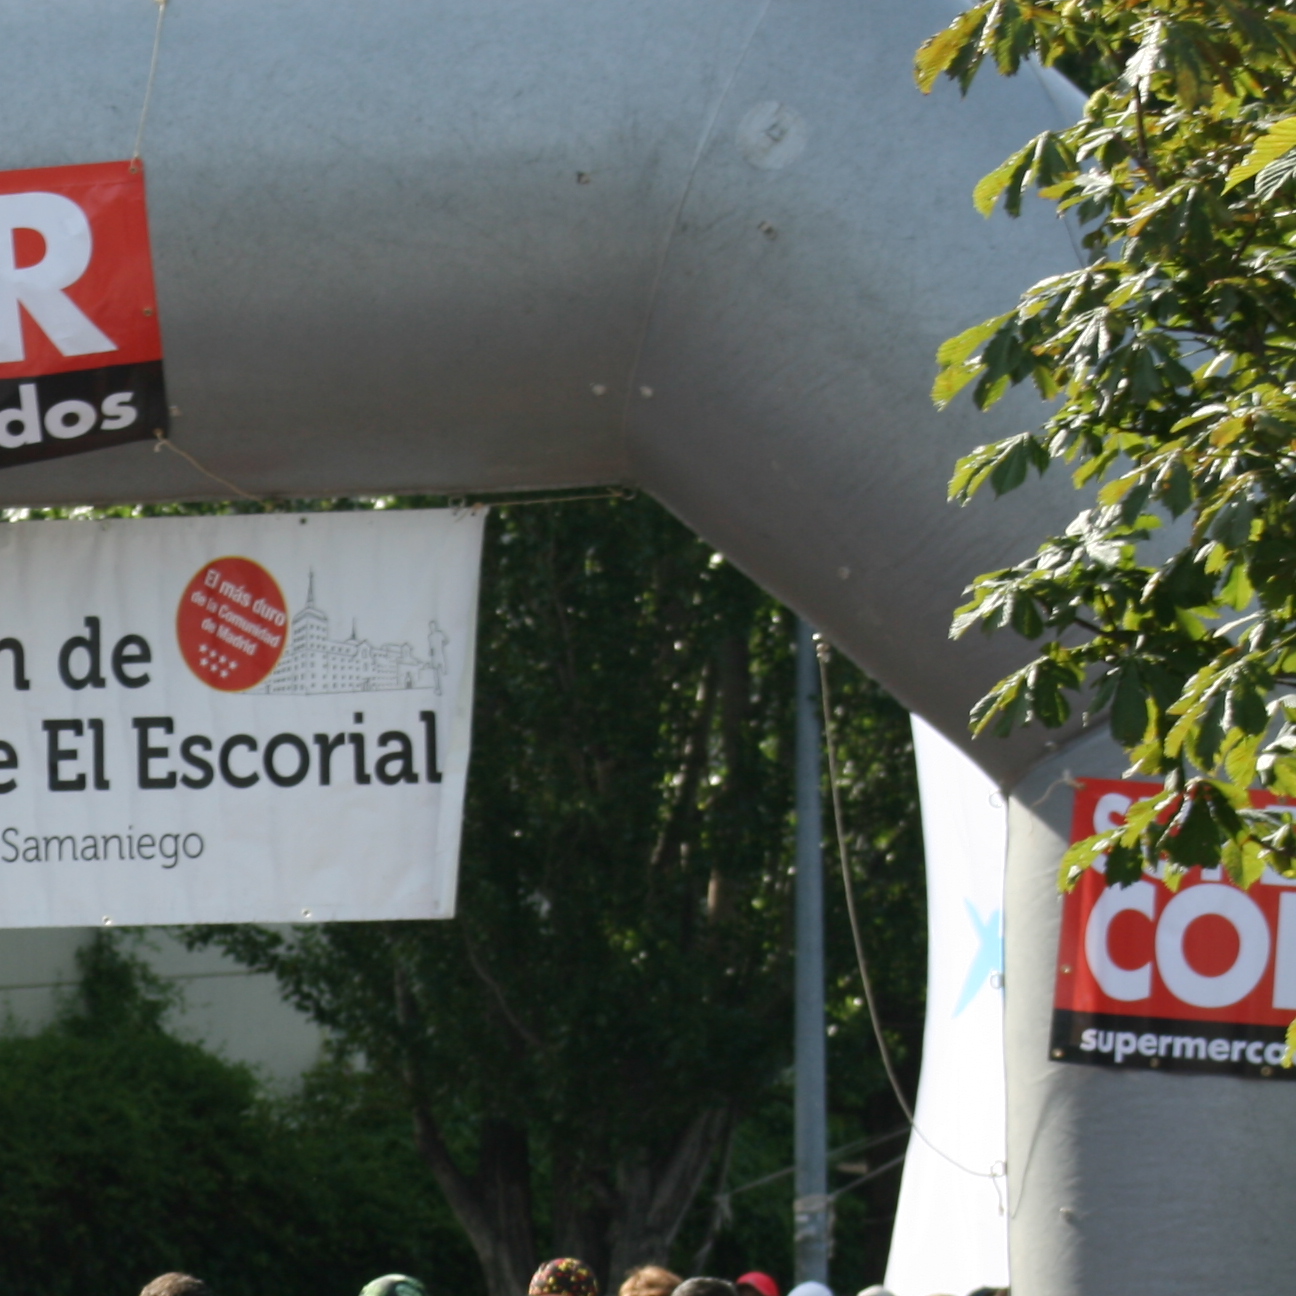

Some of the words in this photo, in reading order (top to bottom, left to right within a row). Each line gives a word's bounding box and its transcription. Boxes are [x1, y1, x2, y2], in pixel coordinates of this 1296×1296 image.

[204, 568, 221, 590] El
[218, 581, 252, 608] más
[251, 597, 287, 627] duro
[216, 624, 259, 656] Madrid
[218, 603, 282, 648] Comunidad
[58, 616, 151, 691] de
[42, 717, 110, 792] El
[132, 711, 442, 790] Escorial
[1, 824, 206, 869] Samaniego
[1079, 1028, 1293, 1064] supermerca
